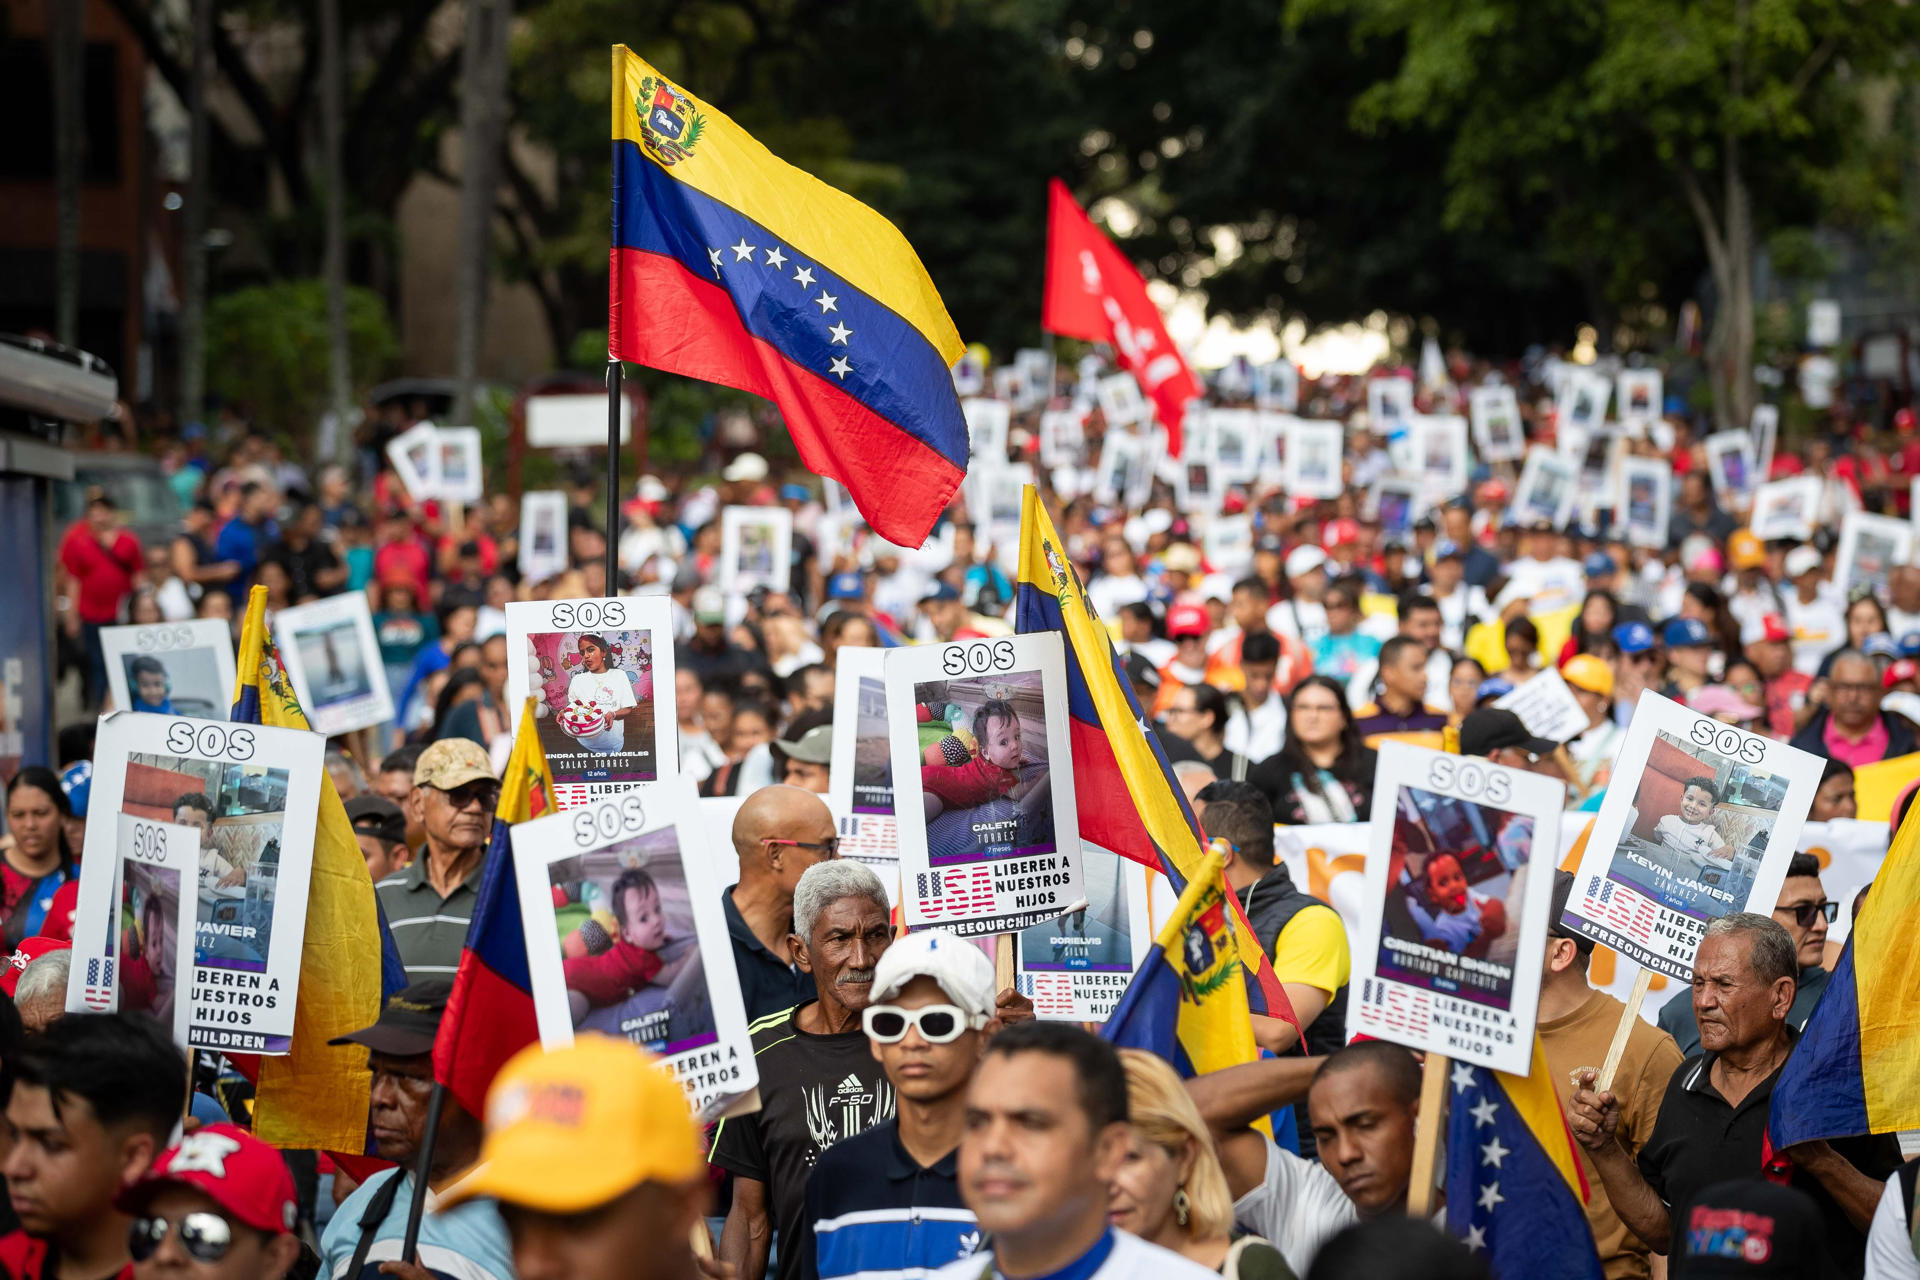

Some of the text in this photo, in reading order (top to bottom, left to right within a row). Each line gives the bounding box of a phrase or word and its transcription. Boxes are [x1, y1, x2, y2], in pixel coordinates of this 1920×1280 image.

[550, 601, 626, 628] SOS
[136, 627, 195, 651] SOS
[943, 641, 1014, 675] SOS
[166, 722, 256, 761] SOS
[1690, 720, 1767, 763] SOS
[560, 758, 630, 769] SALAS TORRES
[1428, 756, 1511, 804] SOS
[553, 785, 588, 811] SA
[573, 796, 646, 846] SOS
[972, 820, 1017, 832] CALETH
[134, 823, 168, 862] SOS
[978, 831, 1014, 843] TORRES
[992, 845, 1011, 853] meses
[994, 856, 1070, 877] LIBEREN A
[1626, 851, 1735, 904] KEVIN JAVIER
[917, 866, 996, 918] USA
[995, 872, 1070, 893] NUESTROS
[1015, 892, 1057, 908] HIJOS
[1583, 874, 1657, 945] USA
[1659, 909, 1706, 935] LIBER
[1050, 937, 1102, 945] DORIELVIS
[1654, 922, 1699, 947] NUES
[1064, 947, 1089, 957] SILVA
[1383, 936, 1458, 966] CRISTIAN
[1582, 922, 1693, 979] #FREEOURCHILD
[1668, 944, 1694, 961] HIJ
[197, 970, 280, 991] BEREN A
[1073, 975, 1128, 986] LIBEREN
[191, 988, 276, 1008] UESTROS
[1074, 989, 1123, 999] NUESTR
[196, 1007, 252, 1025] HIJOS
[621, 1009, 670, 1032] CALETH
[1091, 1004, 1117, 1014] HIJO
[1361, 978, 1430, 1040] USA
[1434, 997, 1518, 1029] LIBEREN A
[1432, 1014, 1514, 1044] NUESTROS
[729, 1046, 738, 1059] A
[1448, 1034, 1494, 1056] HIJOS
[837, 1086, 864, 1094] adidas
